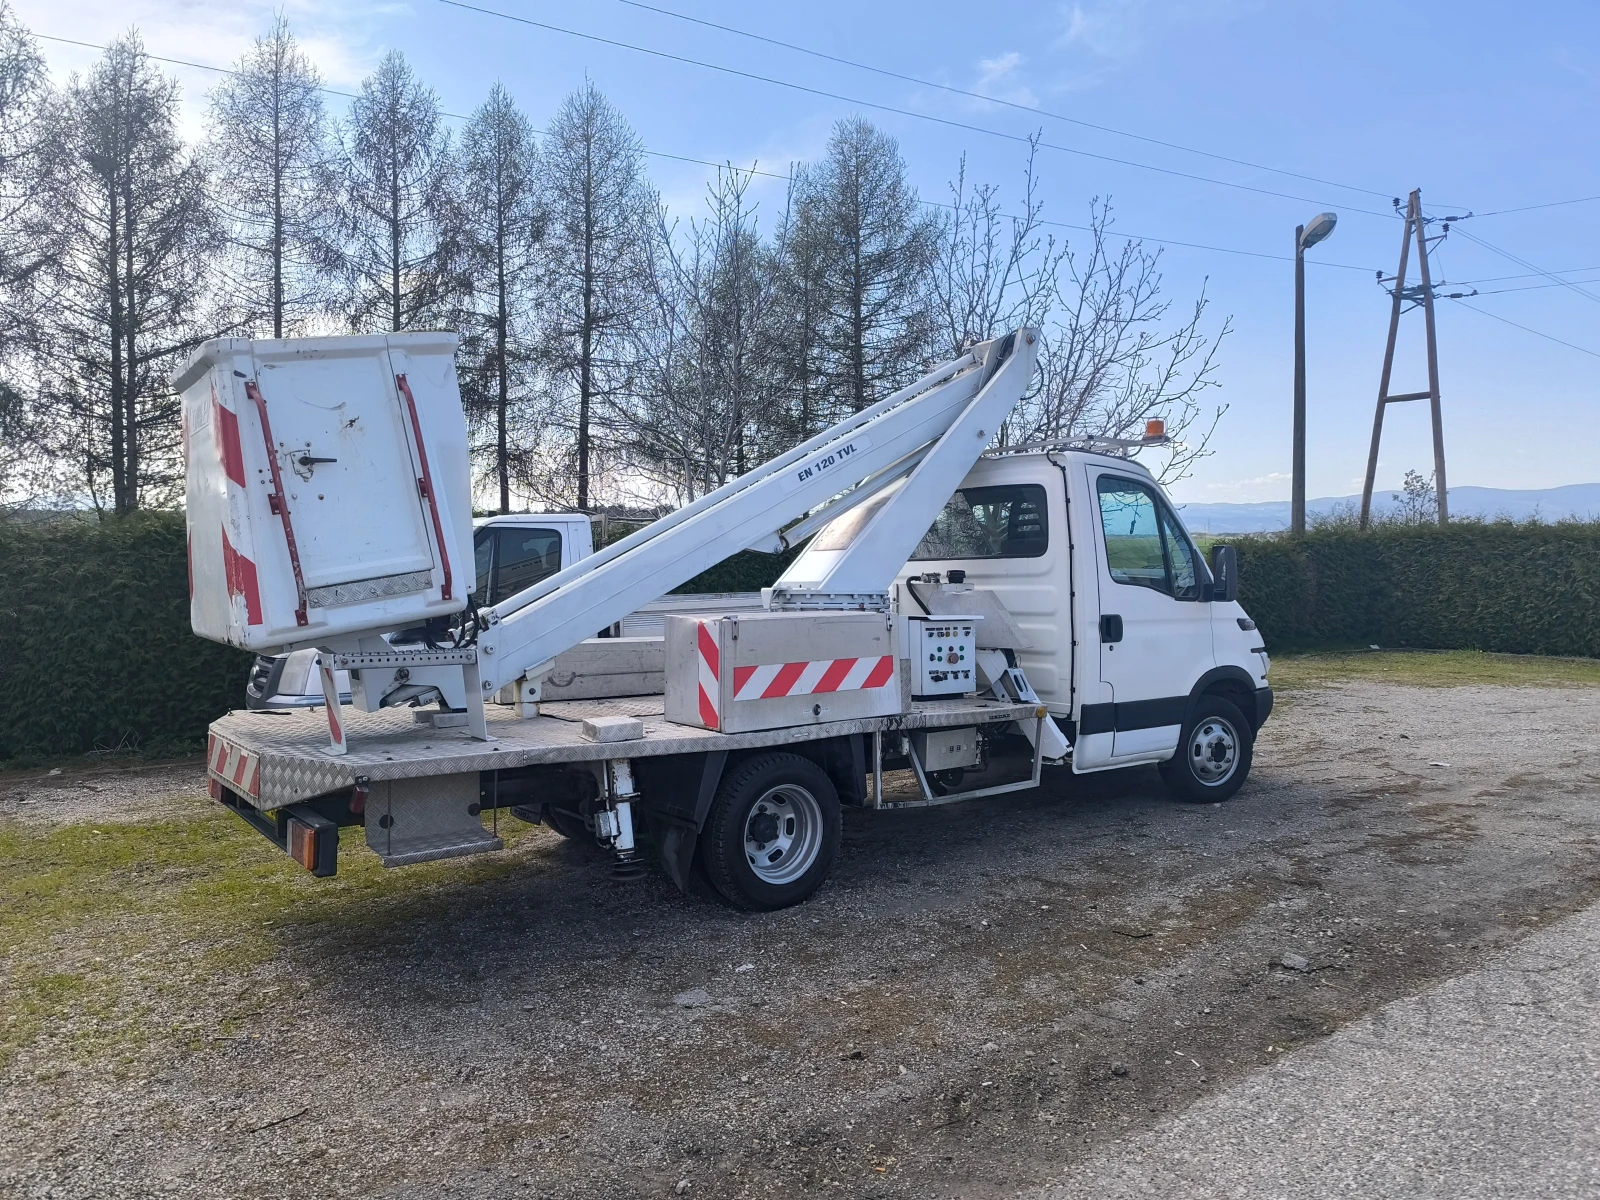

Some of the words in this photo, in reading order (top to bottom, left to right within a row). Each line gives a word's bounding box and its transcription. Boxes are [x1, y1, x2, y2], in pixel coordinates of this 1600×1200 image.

[797, 467, 813, 482] EN
[814, 455, 835, 472] 120
[836, 443, 858, 460] TVL
